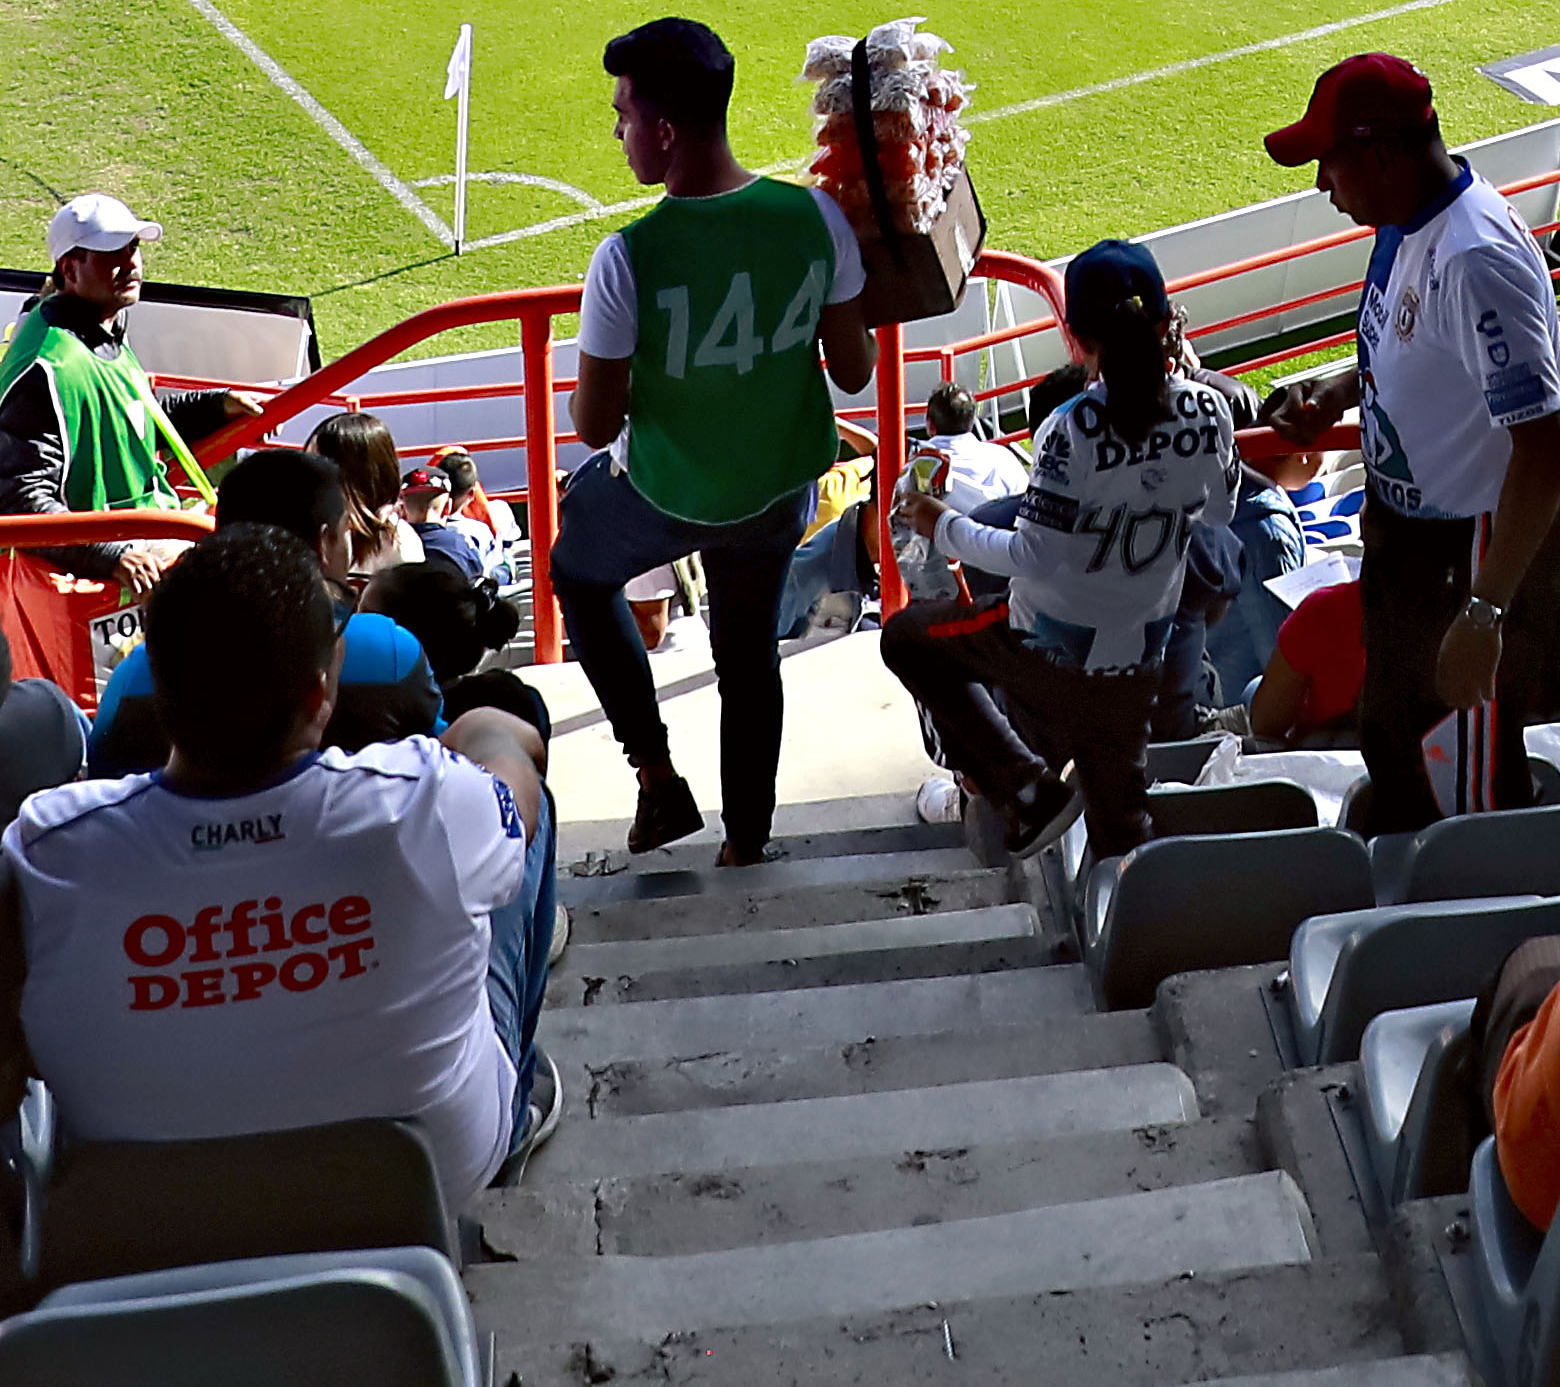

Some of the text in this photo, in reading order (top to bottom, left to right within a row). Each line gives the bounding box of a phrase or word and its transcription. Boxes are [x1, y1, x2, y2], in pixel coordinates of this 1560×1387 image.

[656, 259, 826, 380] 144
[1367, 286, 1390, 330] Mobil
[1080, 390, 1218, 439] Oce
[93, 608, 145, 645] TO
[191, 814, 283, 846] CHARLY
[123, 895, 373, 967] Office
[127, 937, 375, 1011] DEPOT
